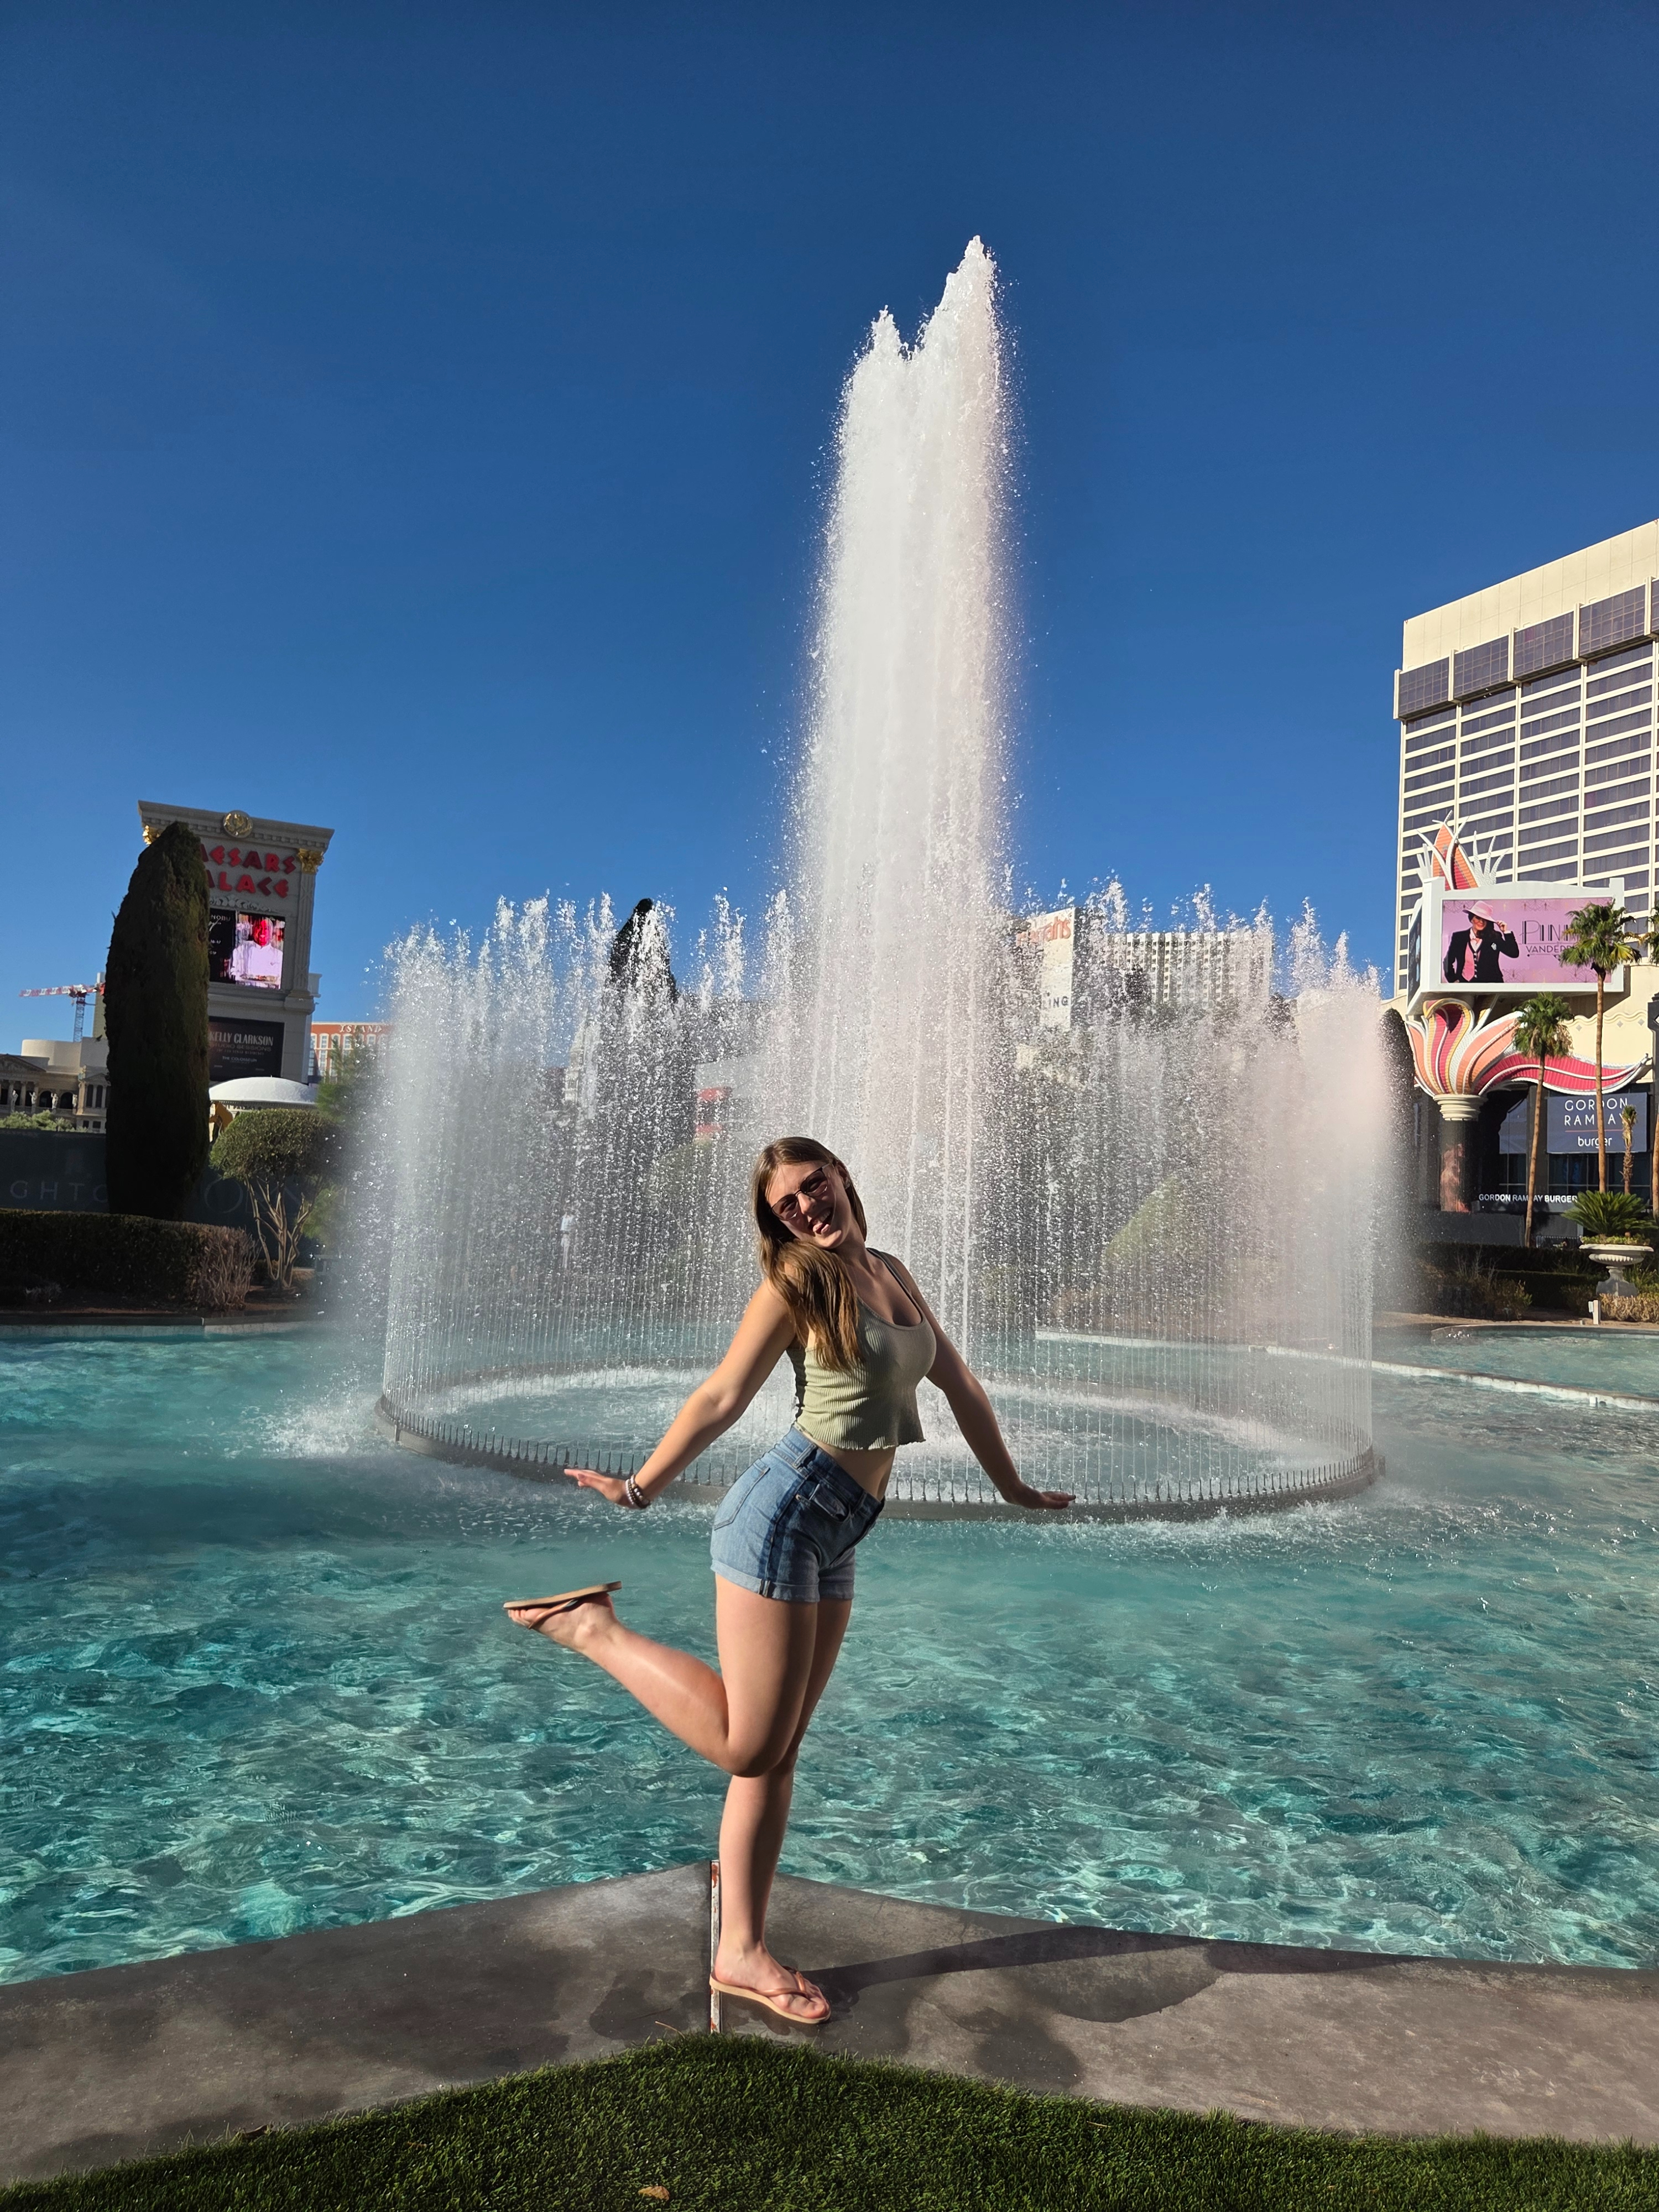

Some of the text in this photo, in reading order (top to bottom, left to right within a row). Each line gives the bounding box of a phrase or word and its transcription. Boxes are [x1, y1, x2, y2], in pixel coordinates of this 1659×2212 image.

[209, 1031, 274, 1046] KELLY CLARKSON
[1564, 1097, 1627, 1112] GORON
[1564, 1113, 1624, 1126] RAMA
[1479, 1194, 1511, 1202] GORDON
